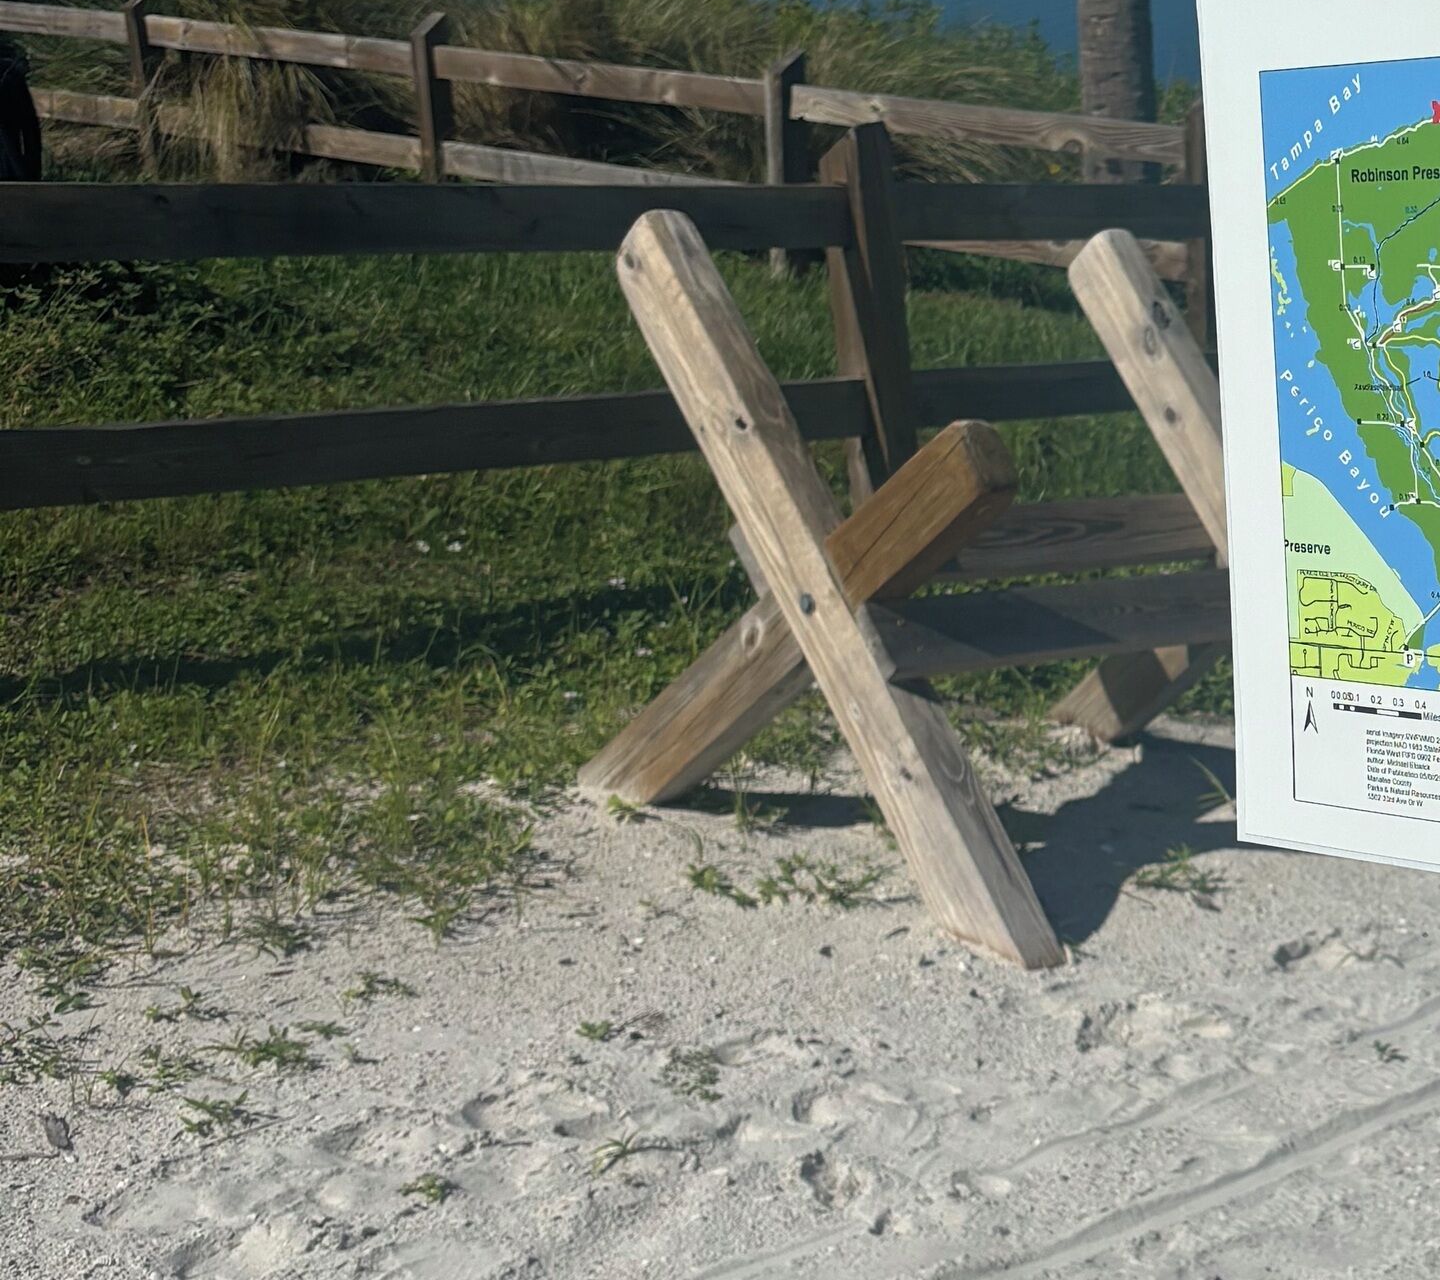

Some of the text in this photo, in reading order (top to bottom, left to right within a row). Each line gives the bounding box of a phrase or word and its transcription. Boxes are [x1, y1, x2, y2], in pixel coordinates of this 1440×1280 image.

[1270, 73, 1361, 180] Tampa Bay
[1351, 168, 1409, 183] Robinson
[1280, 370, 1332, 441] Perico
[1339, 450, 1390, 518] Bayou
[1284, 539, 1331, 555] Preserve
[1306, 687, 1314, 698] N
[1370, 695, 1382, 705] 0.2
[1392, 697, 1404, 707] 0.3
[1415, 700, 1427, 709] 0.4
